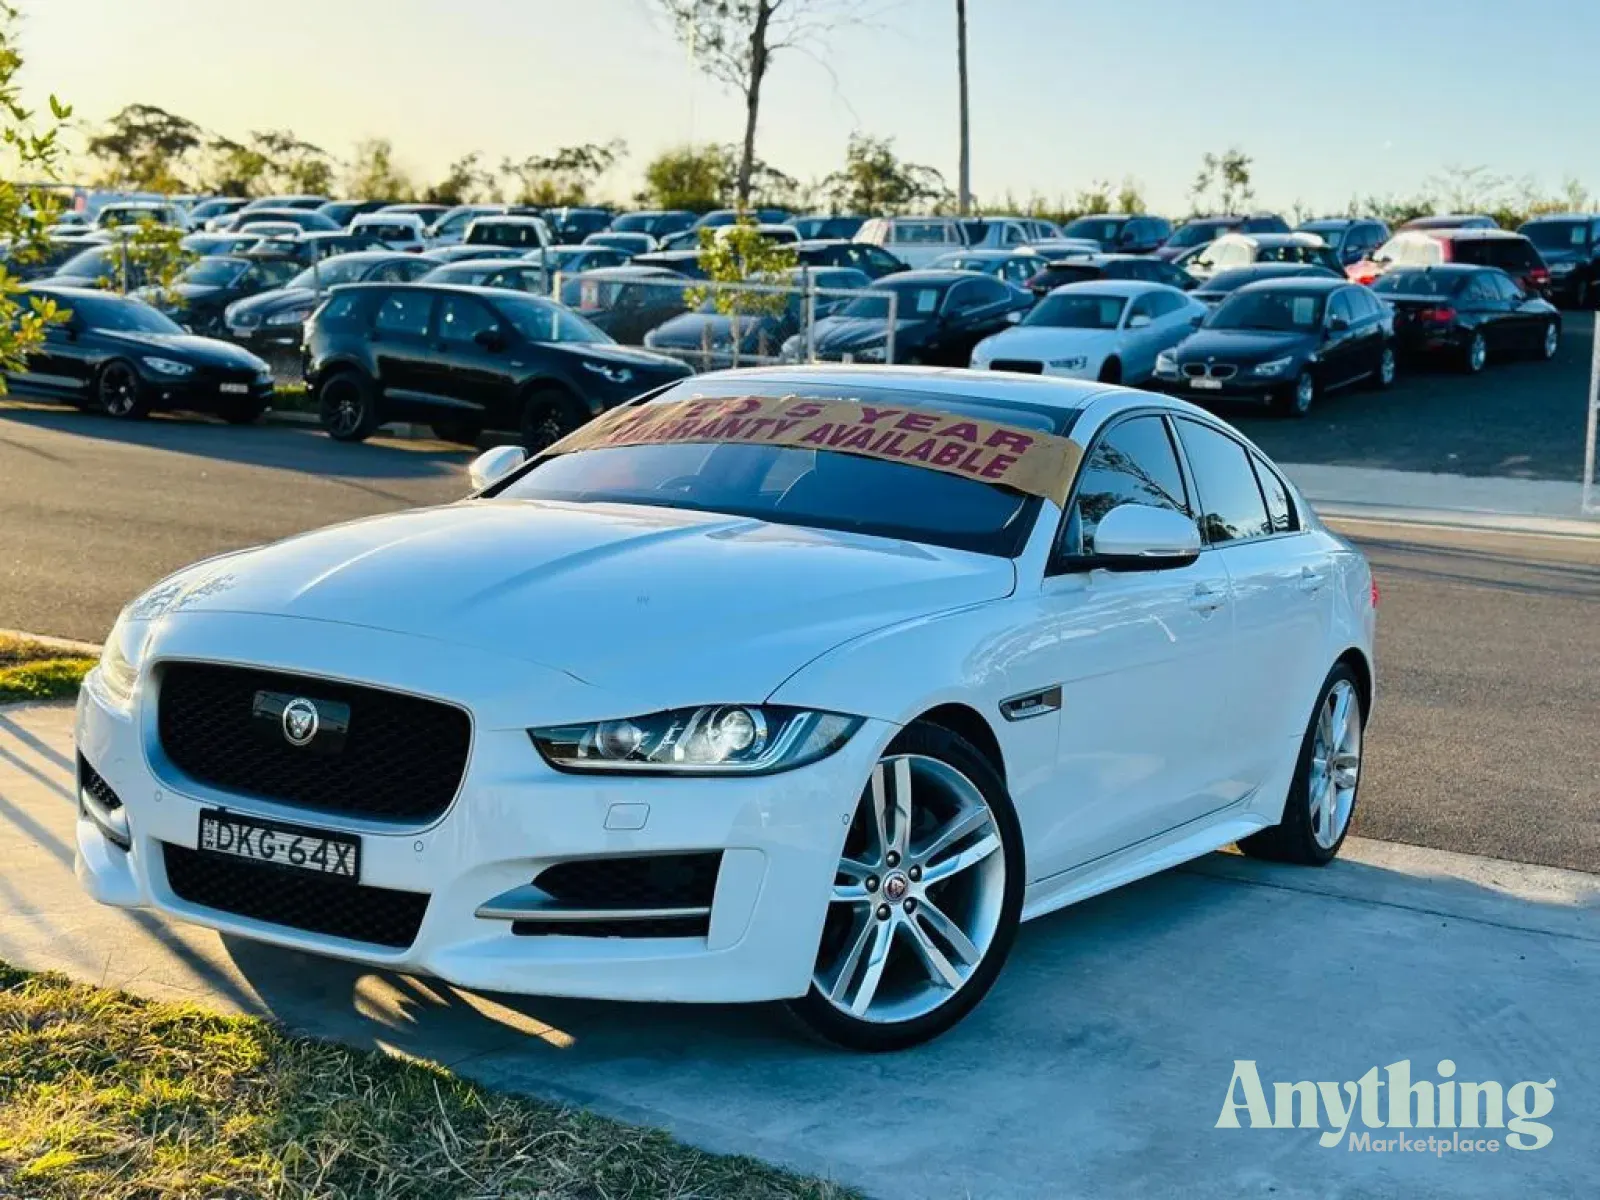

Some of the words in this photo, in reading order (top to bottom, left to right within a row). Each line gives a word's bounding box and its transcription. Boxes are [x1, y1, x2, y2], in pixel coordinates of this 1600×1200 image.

[785, 403, 825, 417] 5
[860, 406, 1034, 454] YEAR
[800, 423, 1018, 478] AVAILABLE
